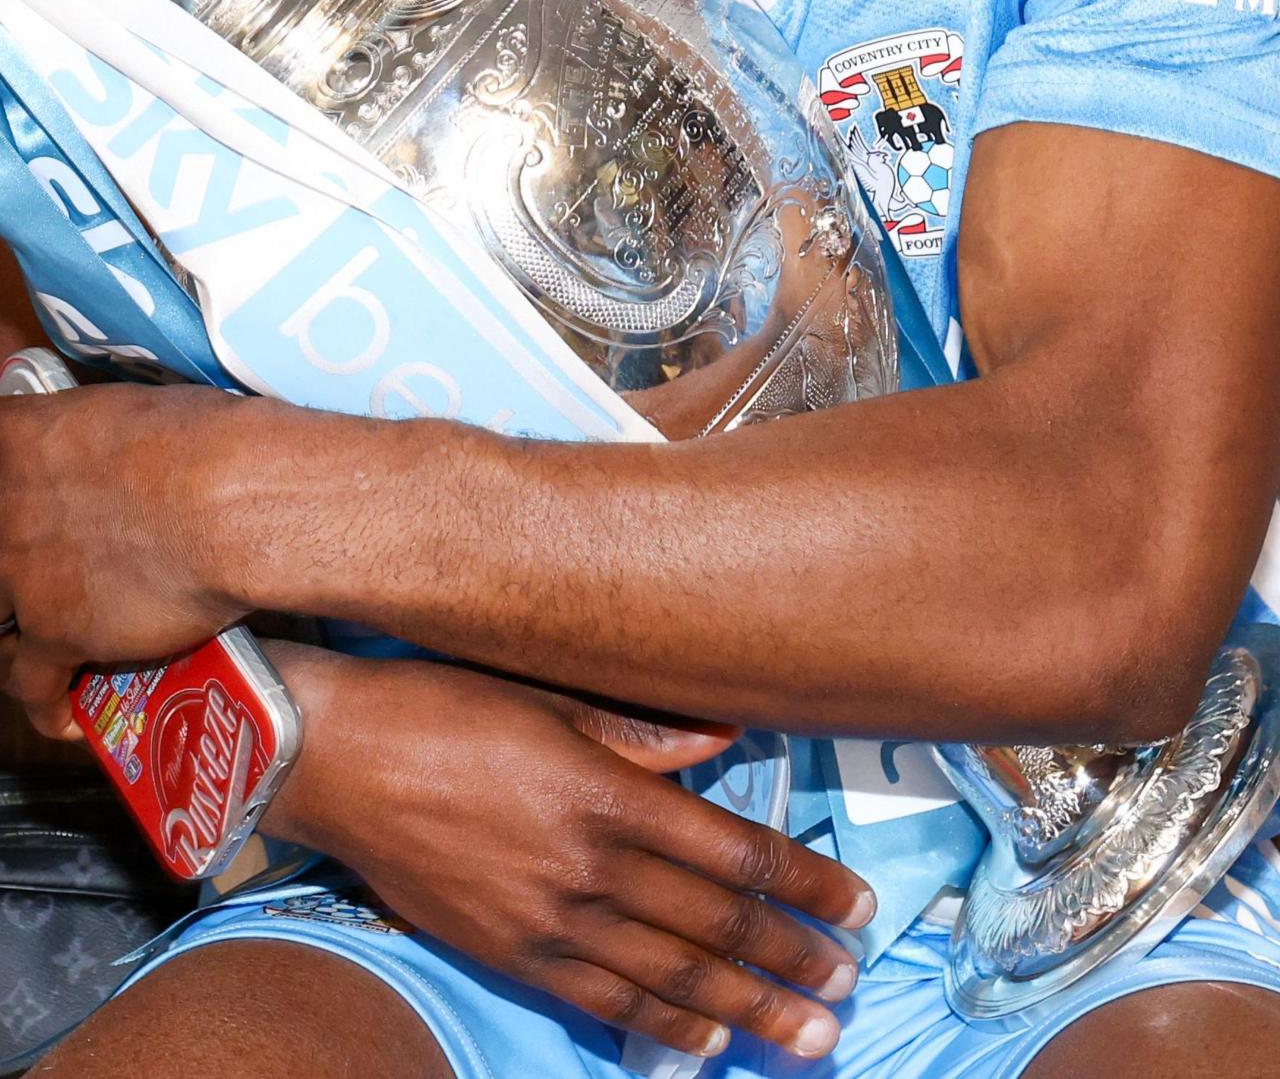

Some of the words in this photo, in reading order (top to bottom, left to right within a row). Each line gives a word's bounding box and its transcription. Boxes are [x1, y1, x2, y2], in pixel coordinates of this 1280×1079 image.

[834, 44, 903, 73] COVENTRY
[907, 37, 942, 51] CITY
[905, 237, 943, 250] FOOT
[279, 245, 516, 434] be
